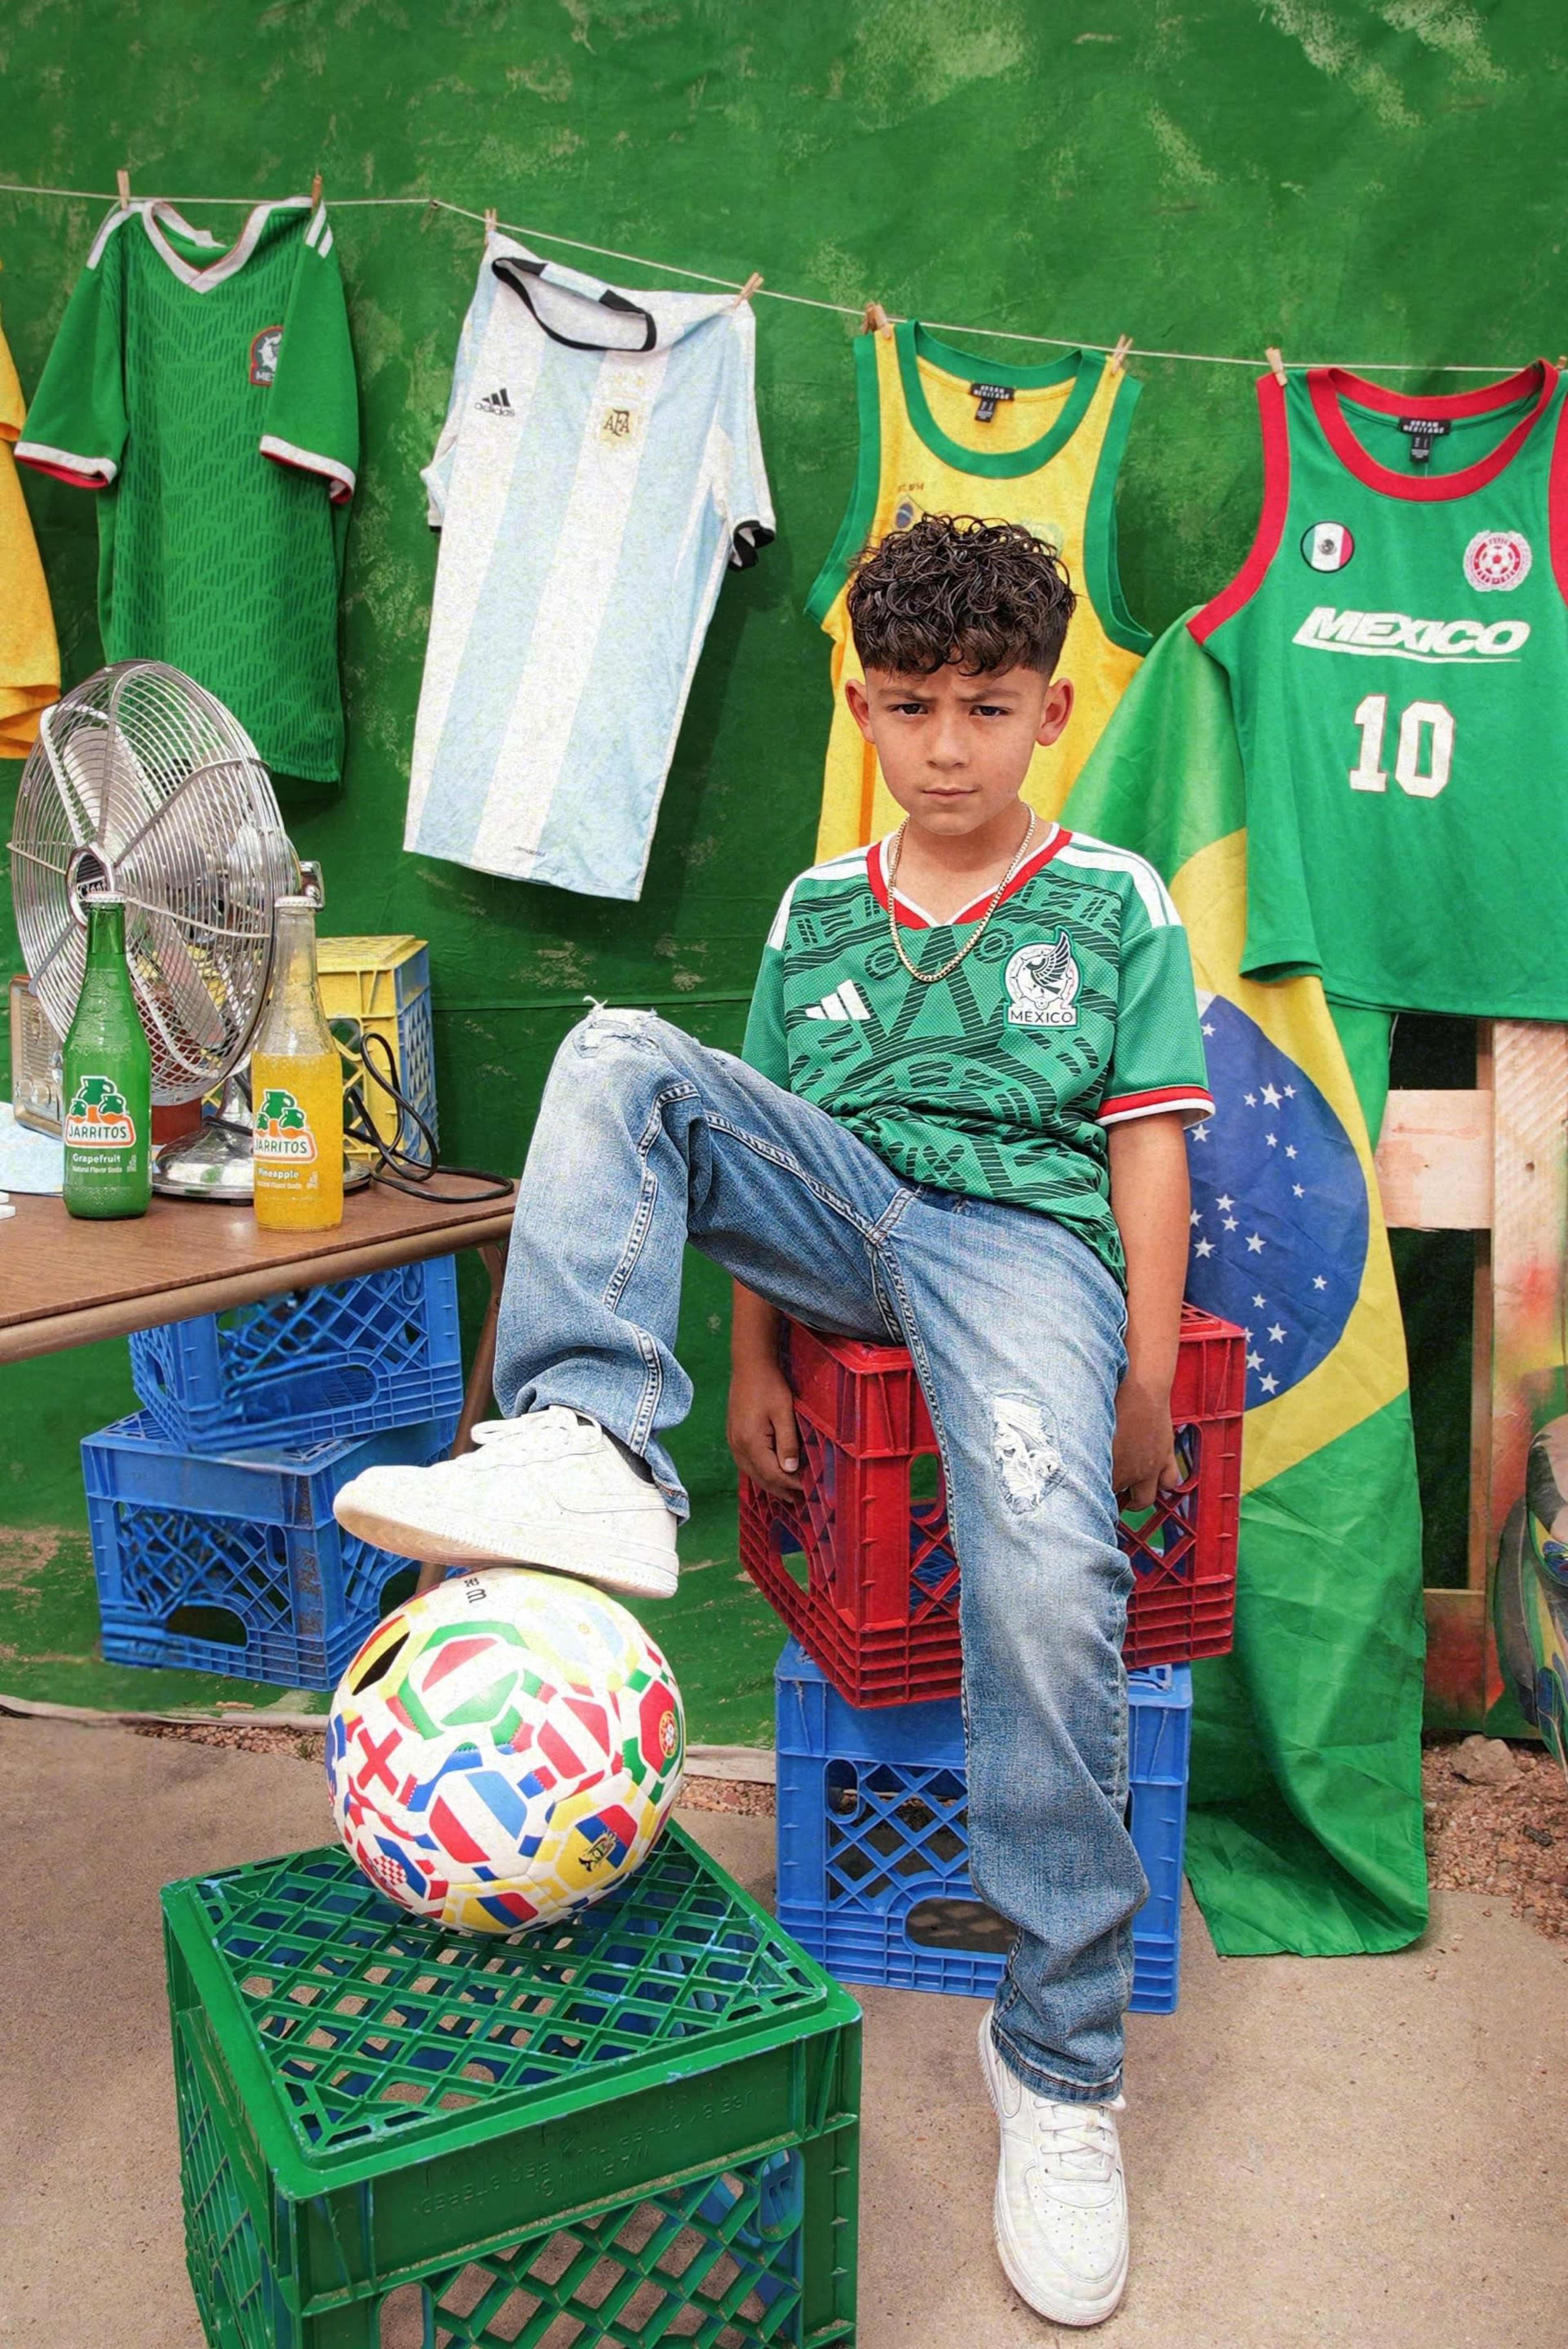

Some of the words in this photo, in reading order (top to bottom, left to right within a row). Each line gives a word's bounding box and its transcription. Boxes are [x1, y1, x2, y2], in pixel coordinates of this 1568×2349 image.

[474, 402, 515, 417] adidas
[603, 408, 630, 436] AFA
[1292, 606, 1531, 656] MEXICO
[1349, 693, 1455, 798] 10
[69, 1126, 127, 1139] JARRITOS
[72, 1153, 120, 1164] Grapefruit
